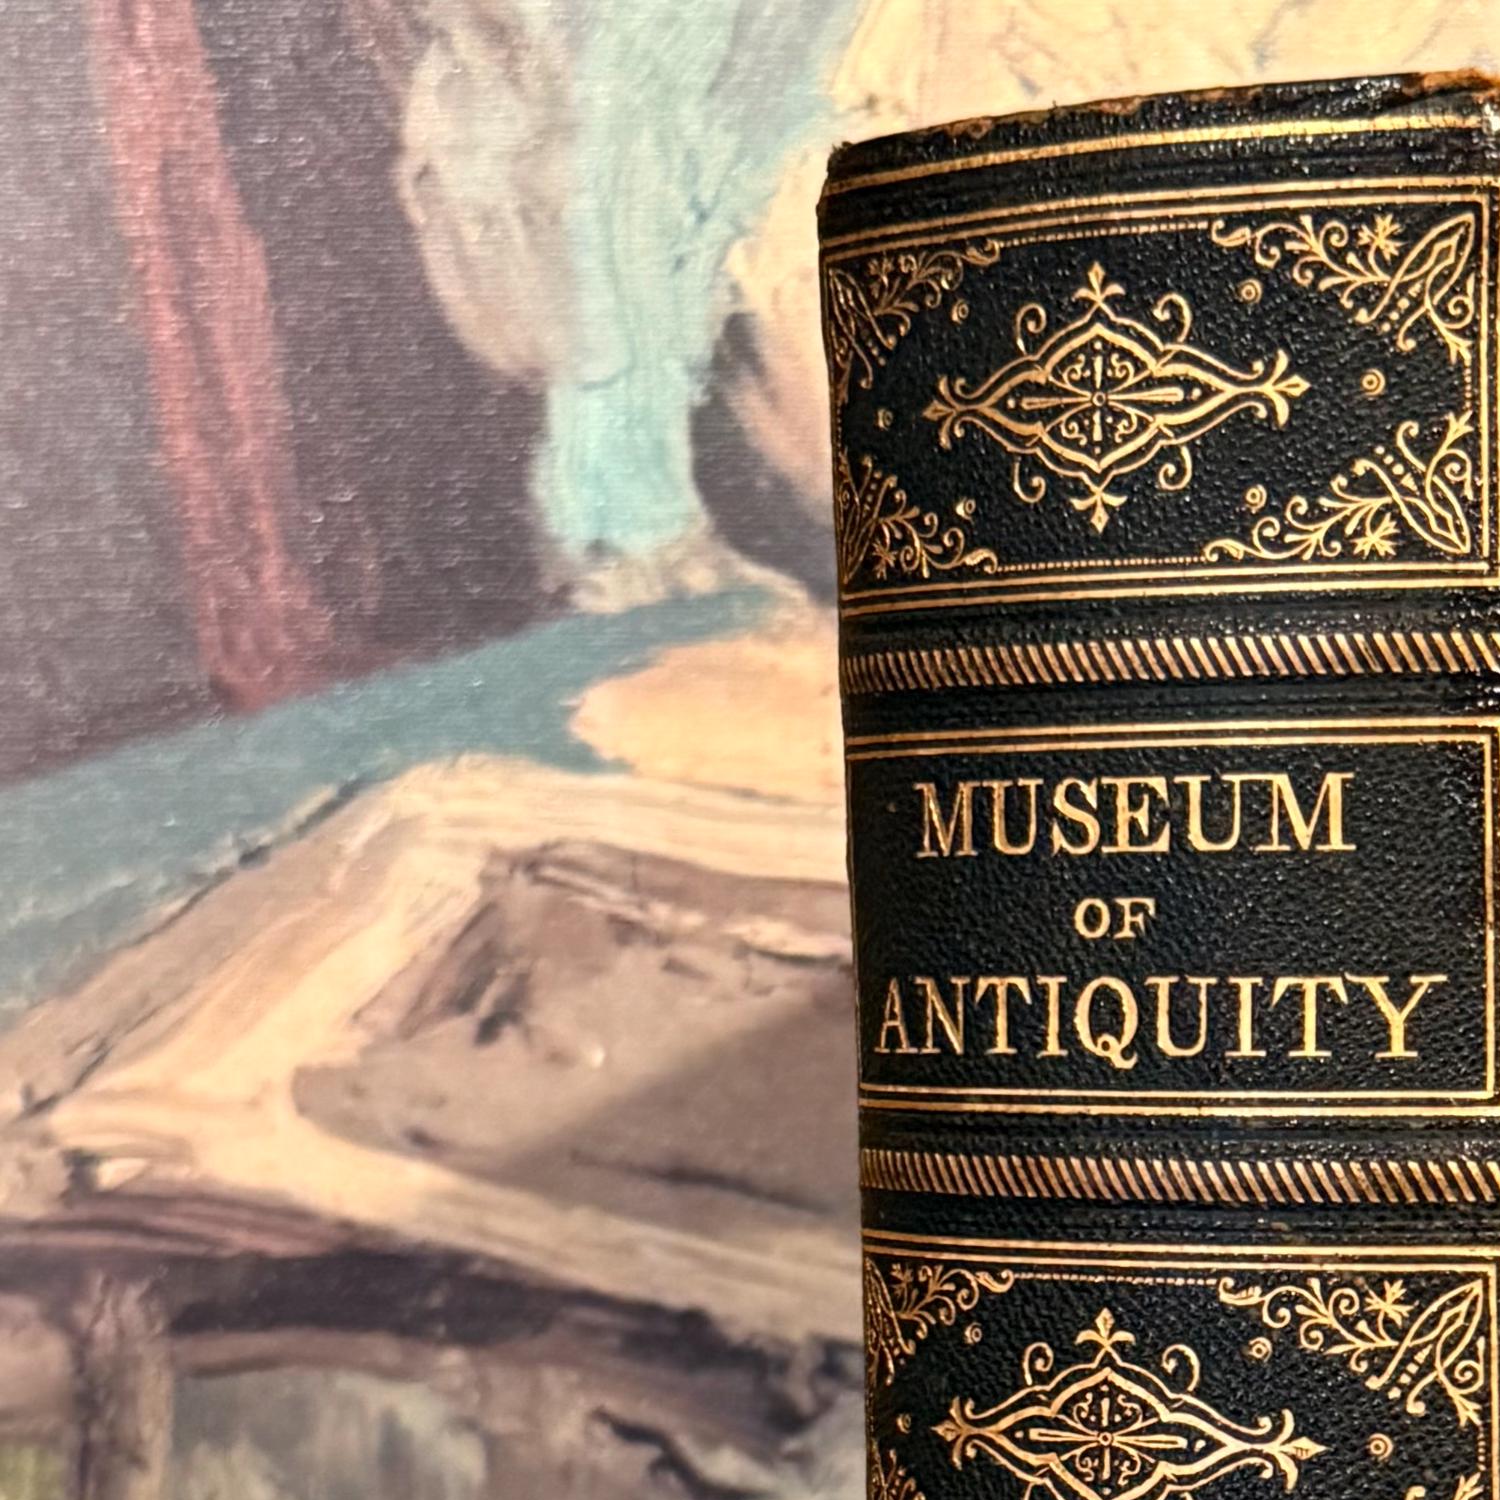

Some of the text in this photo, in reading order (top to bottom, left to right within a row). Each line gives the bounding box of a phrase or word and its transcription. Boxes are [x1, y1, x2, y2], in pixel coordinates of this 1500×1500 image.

[914, 772, 1355, 858] MUSEUM
[1074, 897, 1157, 940] OF
[873, 972, 1448, 1071] ANTIQUITY
